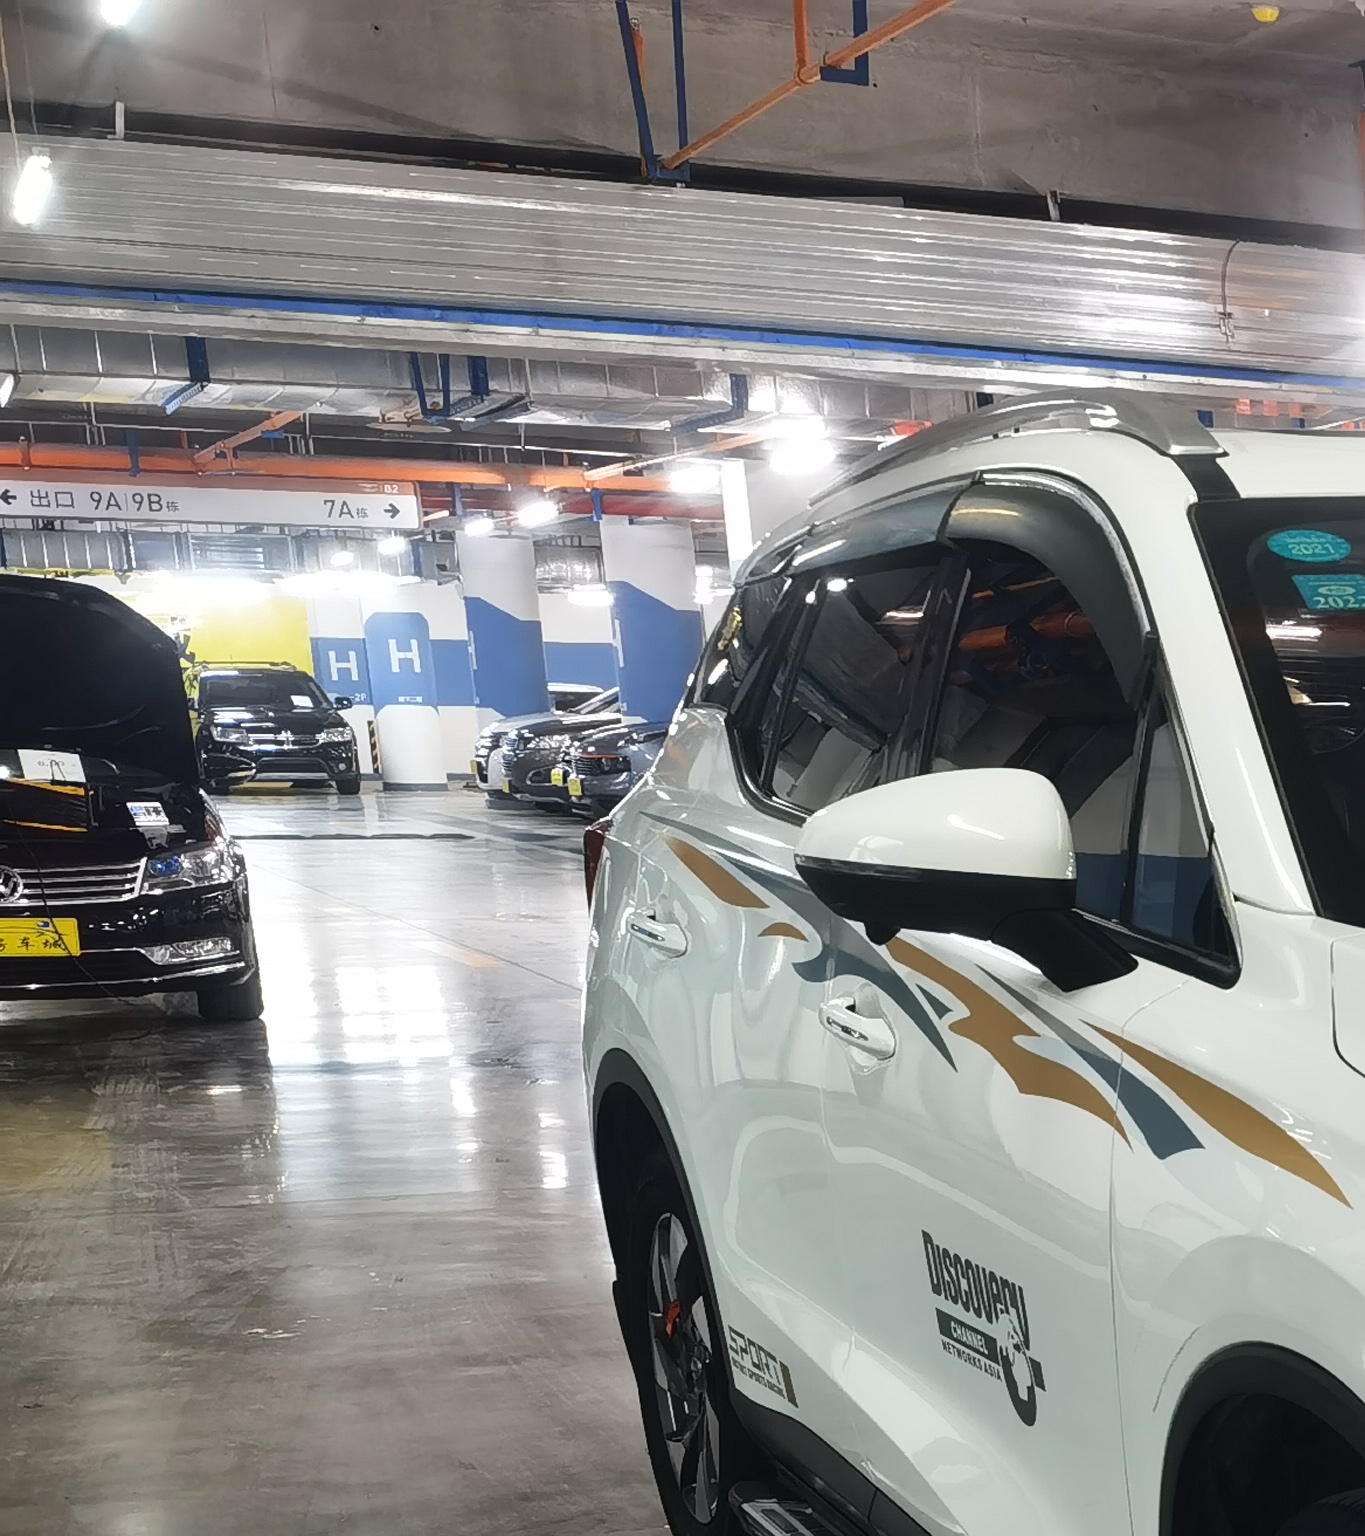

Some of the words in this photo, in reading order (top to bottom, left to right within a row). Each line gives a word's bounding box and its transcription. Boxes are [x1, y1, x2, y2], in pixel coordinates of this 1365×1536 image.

[30, 489, 75, 508] 出口
[384, 484, 399, 494] B2
[1288, 543, 1335, 555] 2021
[328, 650, 359, 681] H
[387, 638, 421, 673] H
[950, 1320, 989, 1355] CHANNEL
[728, 1325, 782, 1386] SPORT
[941, 1338, 983, 1371] NETWORKS
[983, 1360, 1003, 1382] ASIA
